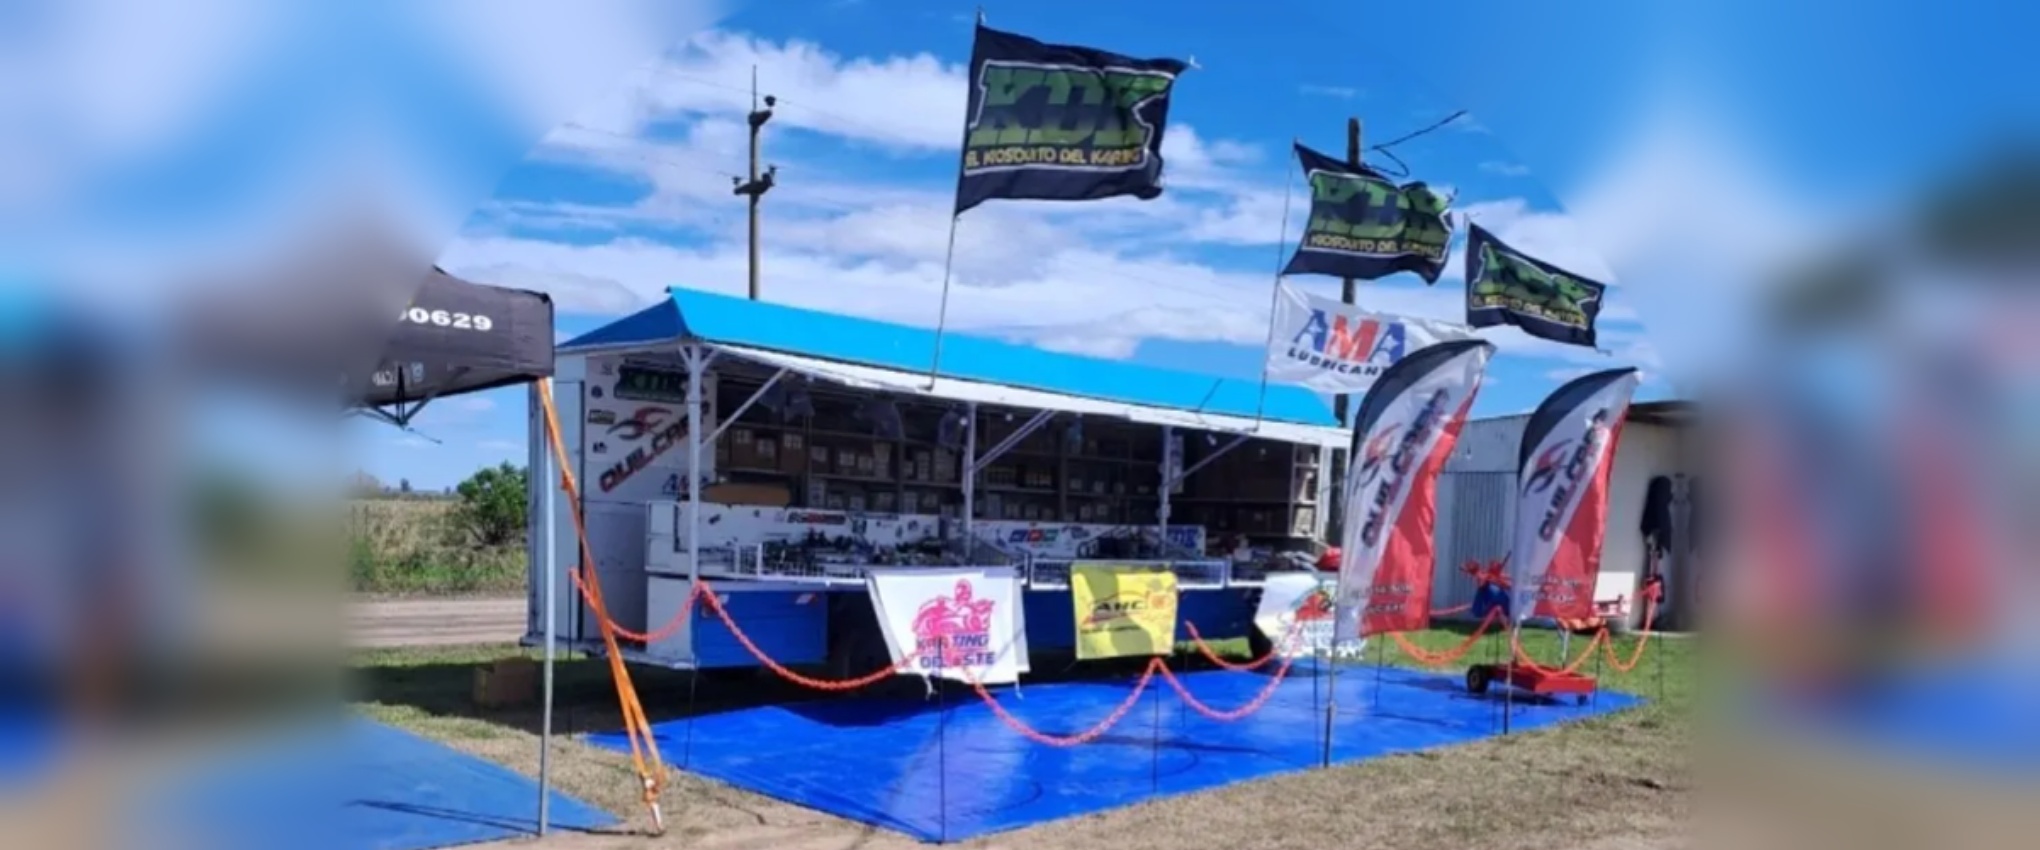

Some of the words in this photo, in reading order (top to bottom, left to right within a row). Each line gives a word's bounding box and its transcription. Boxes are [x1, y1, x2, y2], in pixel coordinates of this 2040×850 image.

[968, 66, 1170, 147] KDK
[1059, 148, 1087, 164] DEL
[1293, 308, 1405, 364] AMA
